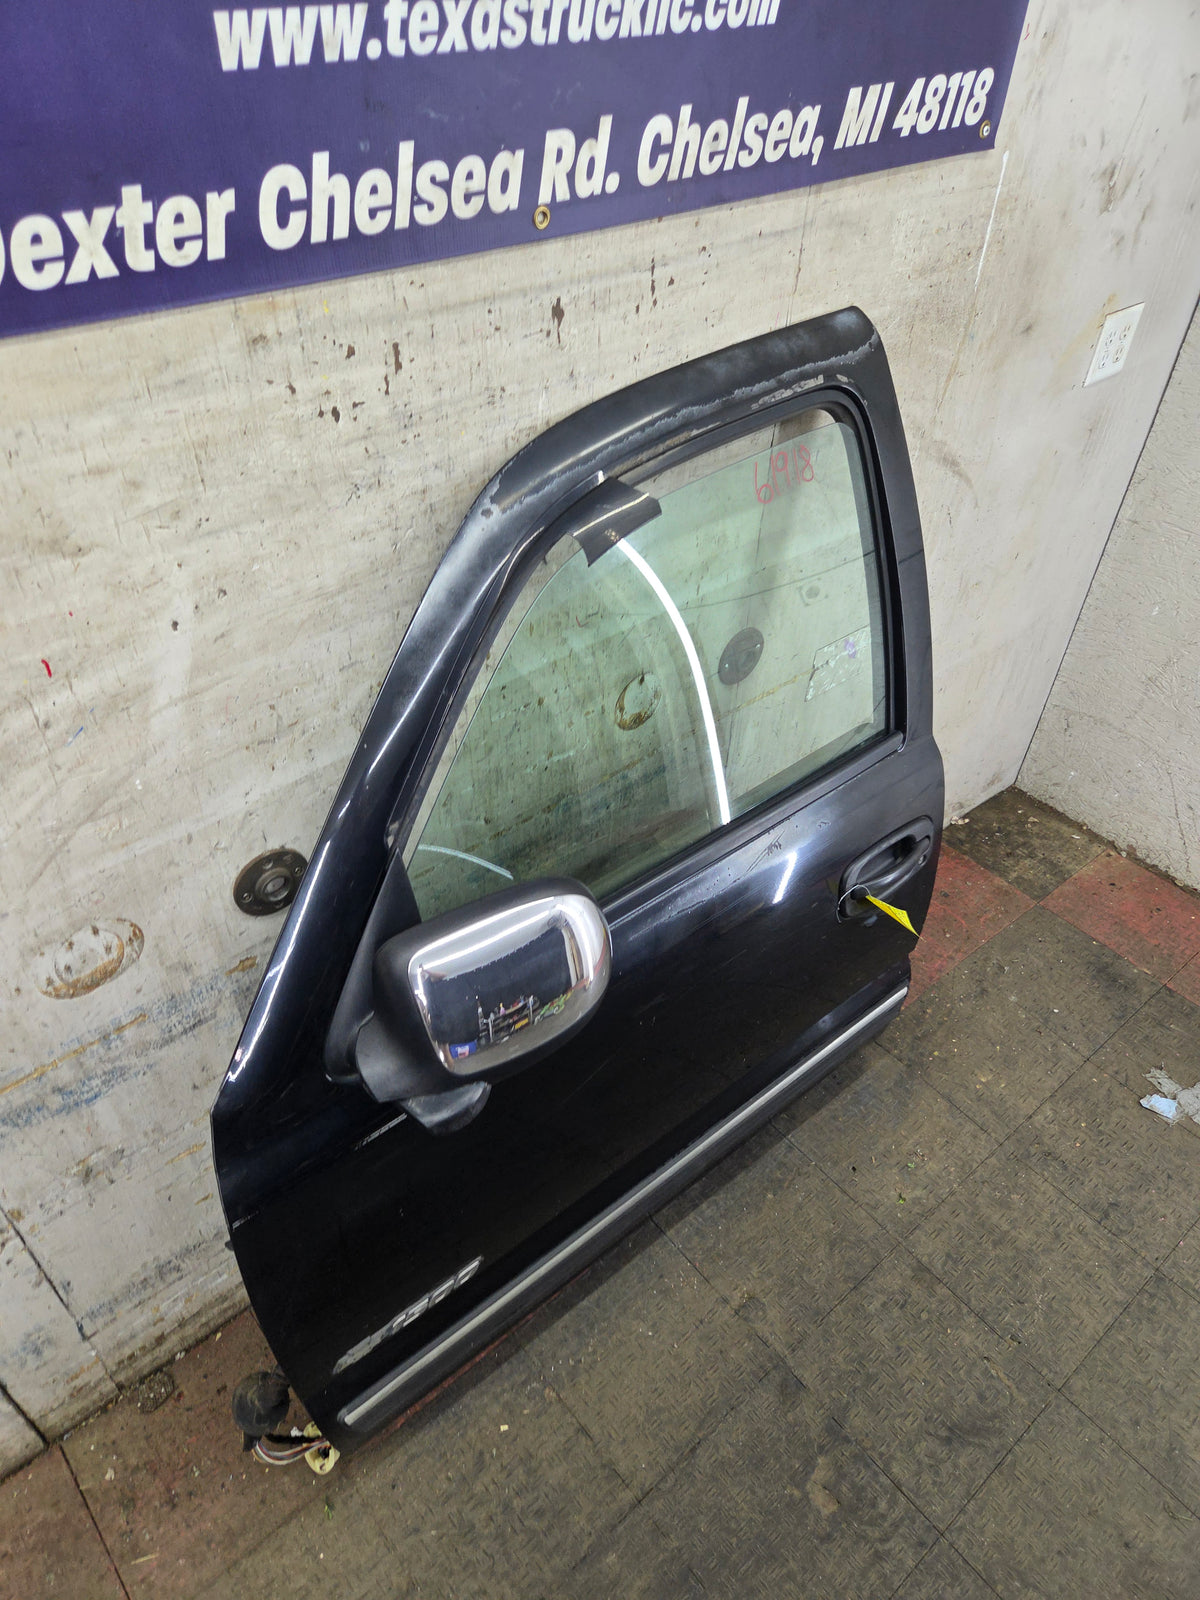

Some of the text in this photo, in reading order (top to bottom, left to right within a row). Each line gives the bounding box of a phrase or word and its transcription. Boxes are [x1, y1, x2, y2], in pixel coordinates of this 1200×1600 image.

[213, 0, 781, 72] www.texastruckllc.com
[0, 68, 995, 291] exter Chelsea Rd. Chelsea, MI 48118
